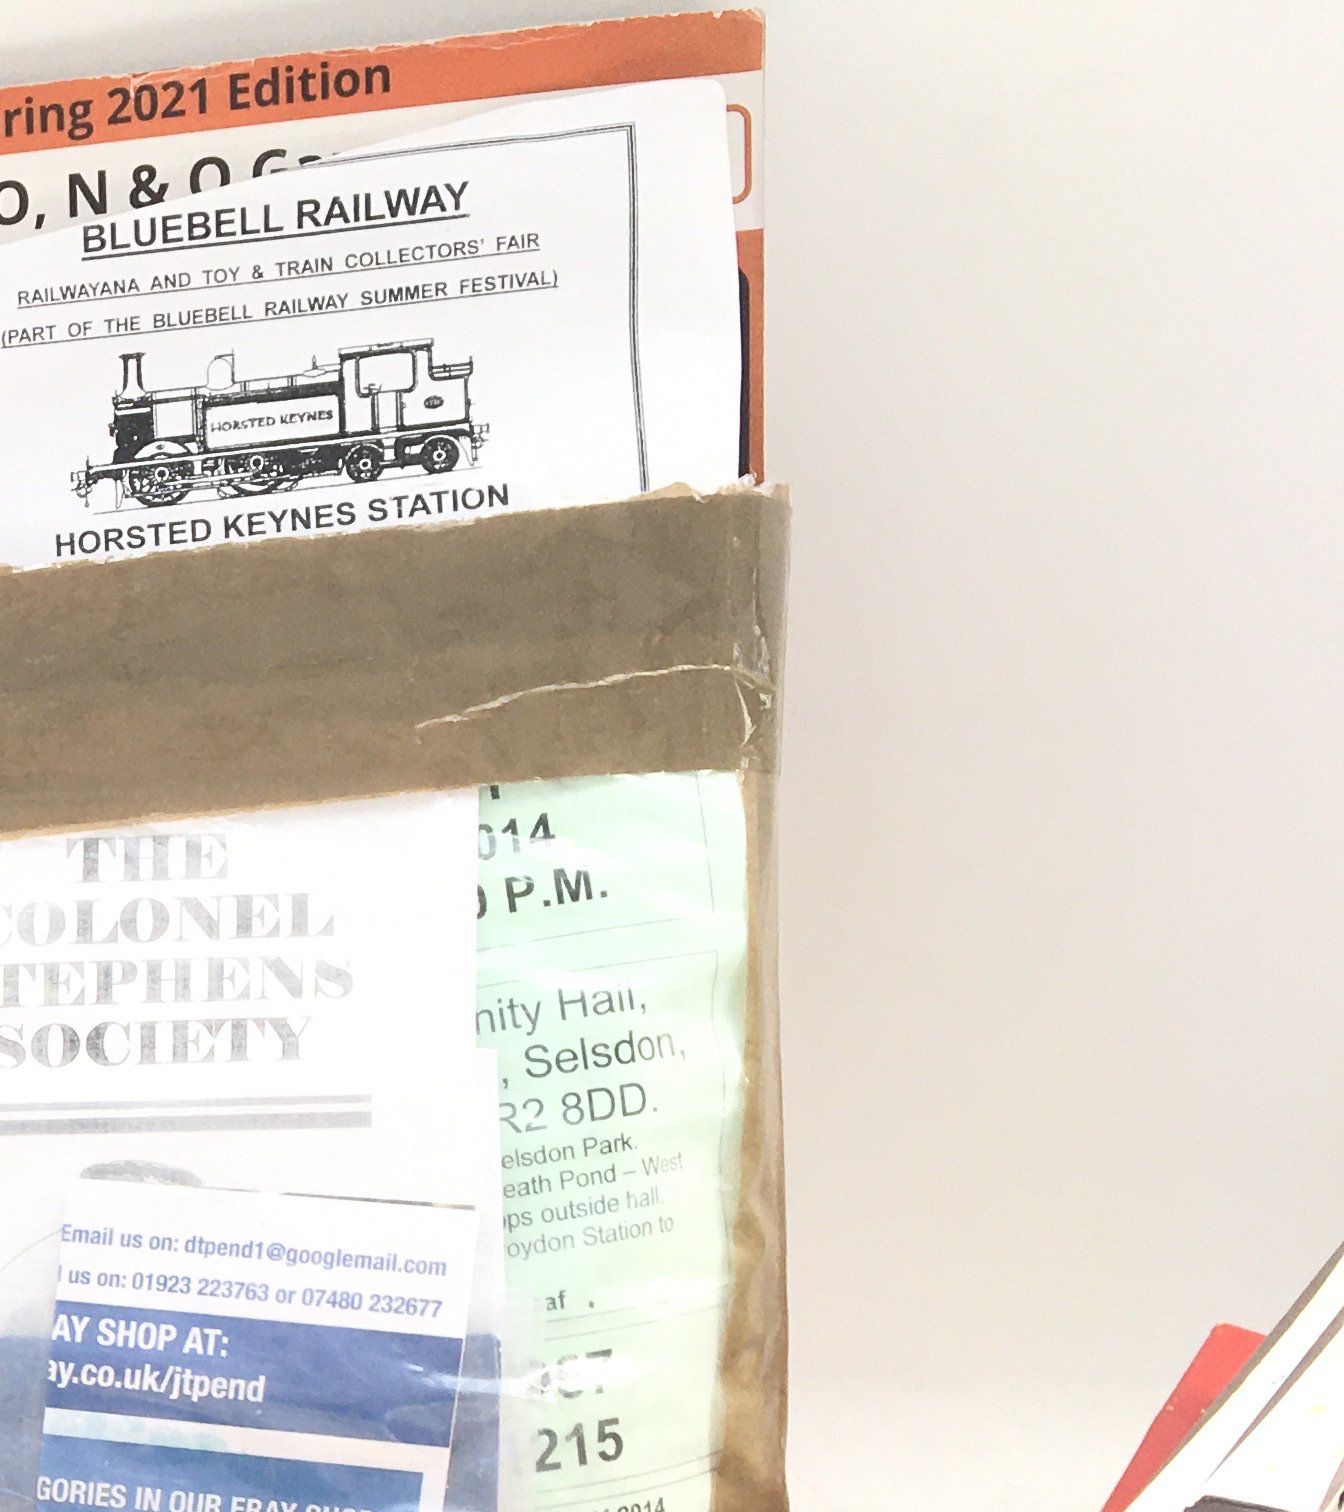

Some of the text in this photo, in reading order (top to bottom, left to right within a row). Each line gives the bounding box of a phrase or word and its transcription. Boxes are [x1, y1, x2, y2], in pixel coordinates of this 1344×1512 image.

[107, 77, 208, 126] 2021
[229, 60, 392, 111] Edition
[67, 170, 108, 218] N
[128, 164, 170, 209] &
[81, 180, 470, 255] BLUEBELL RAILWAY
[17, 232, 540, 306] RAILWAYANA AND TOY & TRAIN COLLECTORS' FAIR
[1, 269, 559, 349] (PART OF THE BLUEBELL RAILWAY SUMMER FESTIVAL)
[210, 409, 334, 434] HORSTED KEYNES
[55, 483, 510, 557] HORSTED KEYNES STATION
[65, 832, 230, 884] THE
[504, 867, 608, 914] P.M.
[524, 1031, 686, 1078] Selsdon,
[561, 1082, 658, 1126] 8DD.
[583, 1132, 638, 1158] Park.
[559, 1164, 617, 1190] Pond
[641, 1152, 684, 1177] West
[541, 1195, 620, 1223] outside
[582, 1222, 653, 1246] Station
[659, 1216, 675, 1233] to
[61, 1223, 447, 1278] Email us on: dtpend1@googlemail.com
[68, 1268, 91, 1286] us
[97, 1271, 126, 1290] on:
[132, 1272, 192, 1295] 01923
[197, 1277, 270, 1302] 223763
[275, 1287, 294, 1305] or
[302, 1287, 363, 1311] 07480
[368, 1293, 443, 1318] 232677
[96, 1317, 178, 1352] SHOP
[182, 1327, 230, 1358] AT:
[535, 1417, 624, 1473] 215
[36, 1475, 127, 1509] GORIES
[134, 1486, 161, 1512] IN
